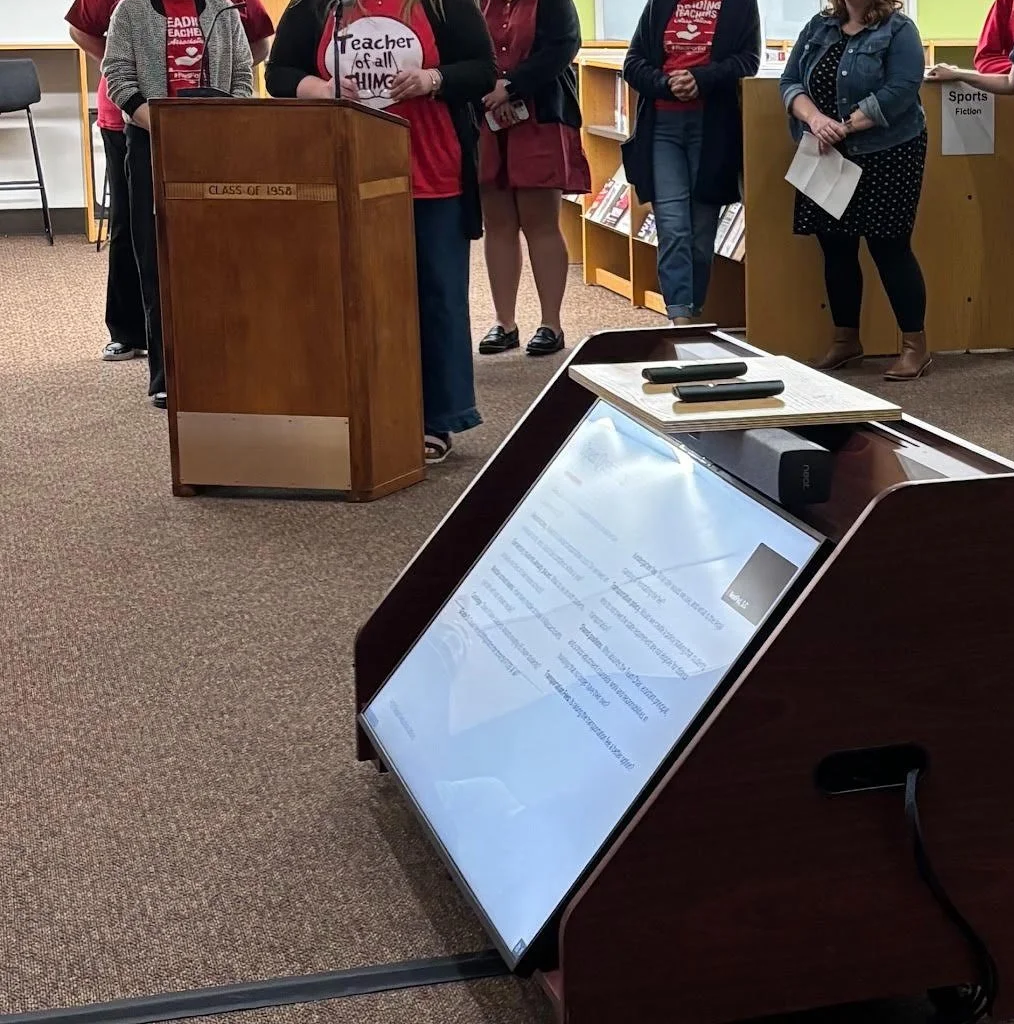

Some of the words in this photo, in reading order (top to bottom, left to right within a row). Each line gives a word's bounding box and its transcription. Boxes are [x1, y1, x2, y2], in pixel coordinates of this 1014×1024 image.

[333, 33, 415, 55] Teacher
[355, 52, 371, 70] of
[374, 50, 393, 69] all
[344, 71, 396, 90] THING
[948, 90, 988, 104] Sports
[955, 107, 982, 116] Fiction
[208, 184, 242, 196] CLASS
[246, 184, 261, 196] OF
[265, 184, 293, 196] 1958
